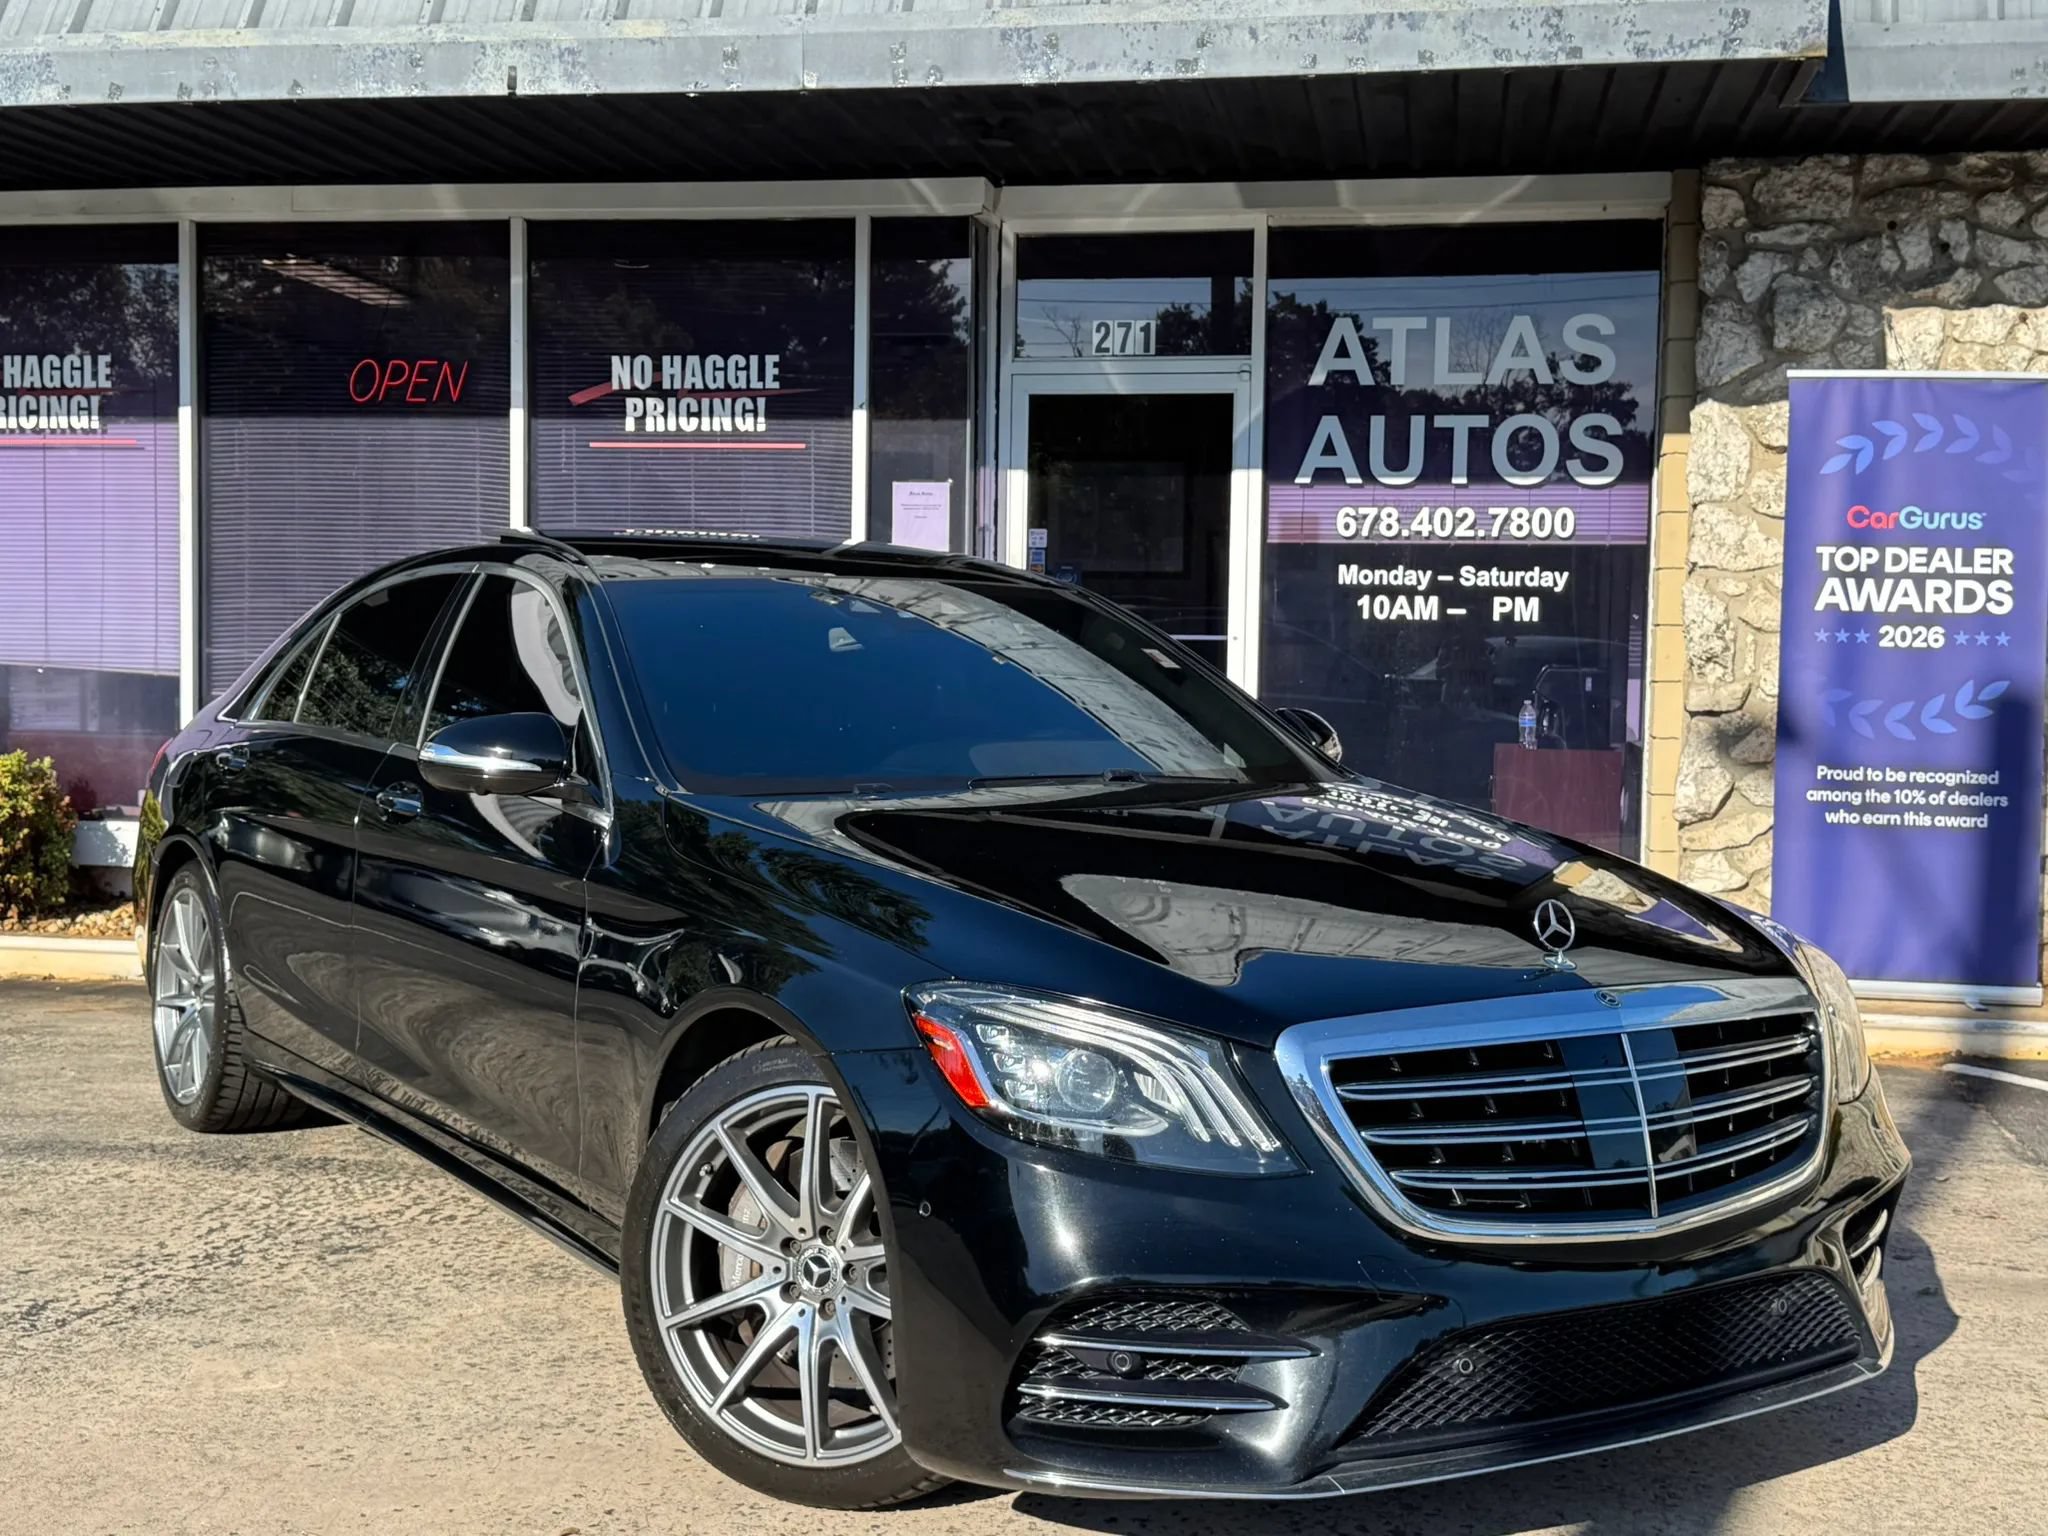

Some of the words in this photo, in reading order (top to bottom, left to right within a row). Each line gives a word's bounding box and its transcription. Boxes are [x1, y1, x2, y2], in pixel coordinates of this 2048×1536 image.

[1094, 322, 1152, 354] 271
[1307, 313, 1617, 386] ATLAS
[3, 354, 112, 388] HAGGLE
[349, 359, 468, 402] OPEN
[611, 354, 654, 390] NO
[663, 354, 780, 390] HAGGLE
[625, 397, 767, 432] PRICING!
[1294, 413, 1625, 486] AUTOS
[1336, 506, 1576, 539] 678.402.7800
[1815, 545, 1880, 572] TOP
[1884, 547, 2014, 575] DEALER
[1338, 564, 1432, 590] Monday
[1459, 566, 1569, 591] Saturday
[1357, 595, 1439, 621] 10AM
[1492, 597, 1540, 622] PM
[1814, 577, 2014, 616] AWARDS
[1878, 624, 1946, 649] 2026
[1817, 765, 1863, 782] Proud
[1867, 767, 1883, 782] to
[1886, 767, 1907, 783] be
[1909, 768, 1999, 786] recognized
[1806, 789, 1862, 807] among
[1865, 788, 1891, 804] the
[1894, 789, 1926, 806] 10%
[1929, 789, 1947, 807] of
[1948, 790, 2008, 808] dealers
[1825, 809, 1860, 825] who
[1862, 813, 1901, 826] earn
[1903, 811, 1932, 827] this
[1934, 811, 1988, 829] award
